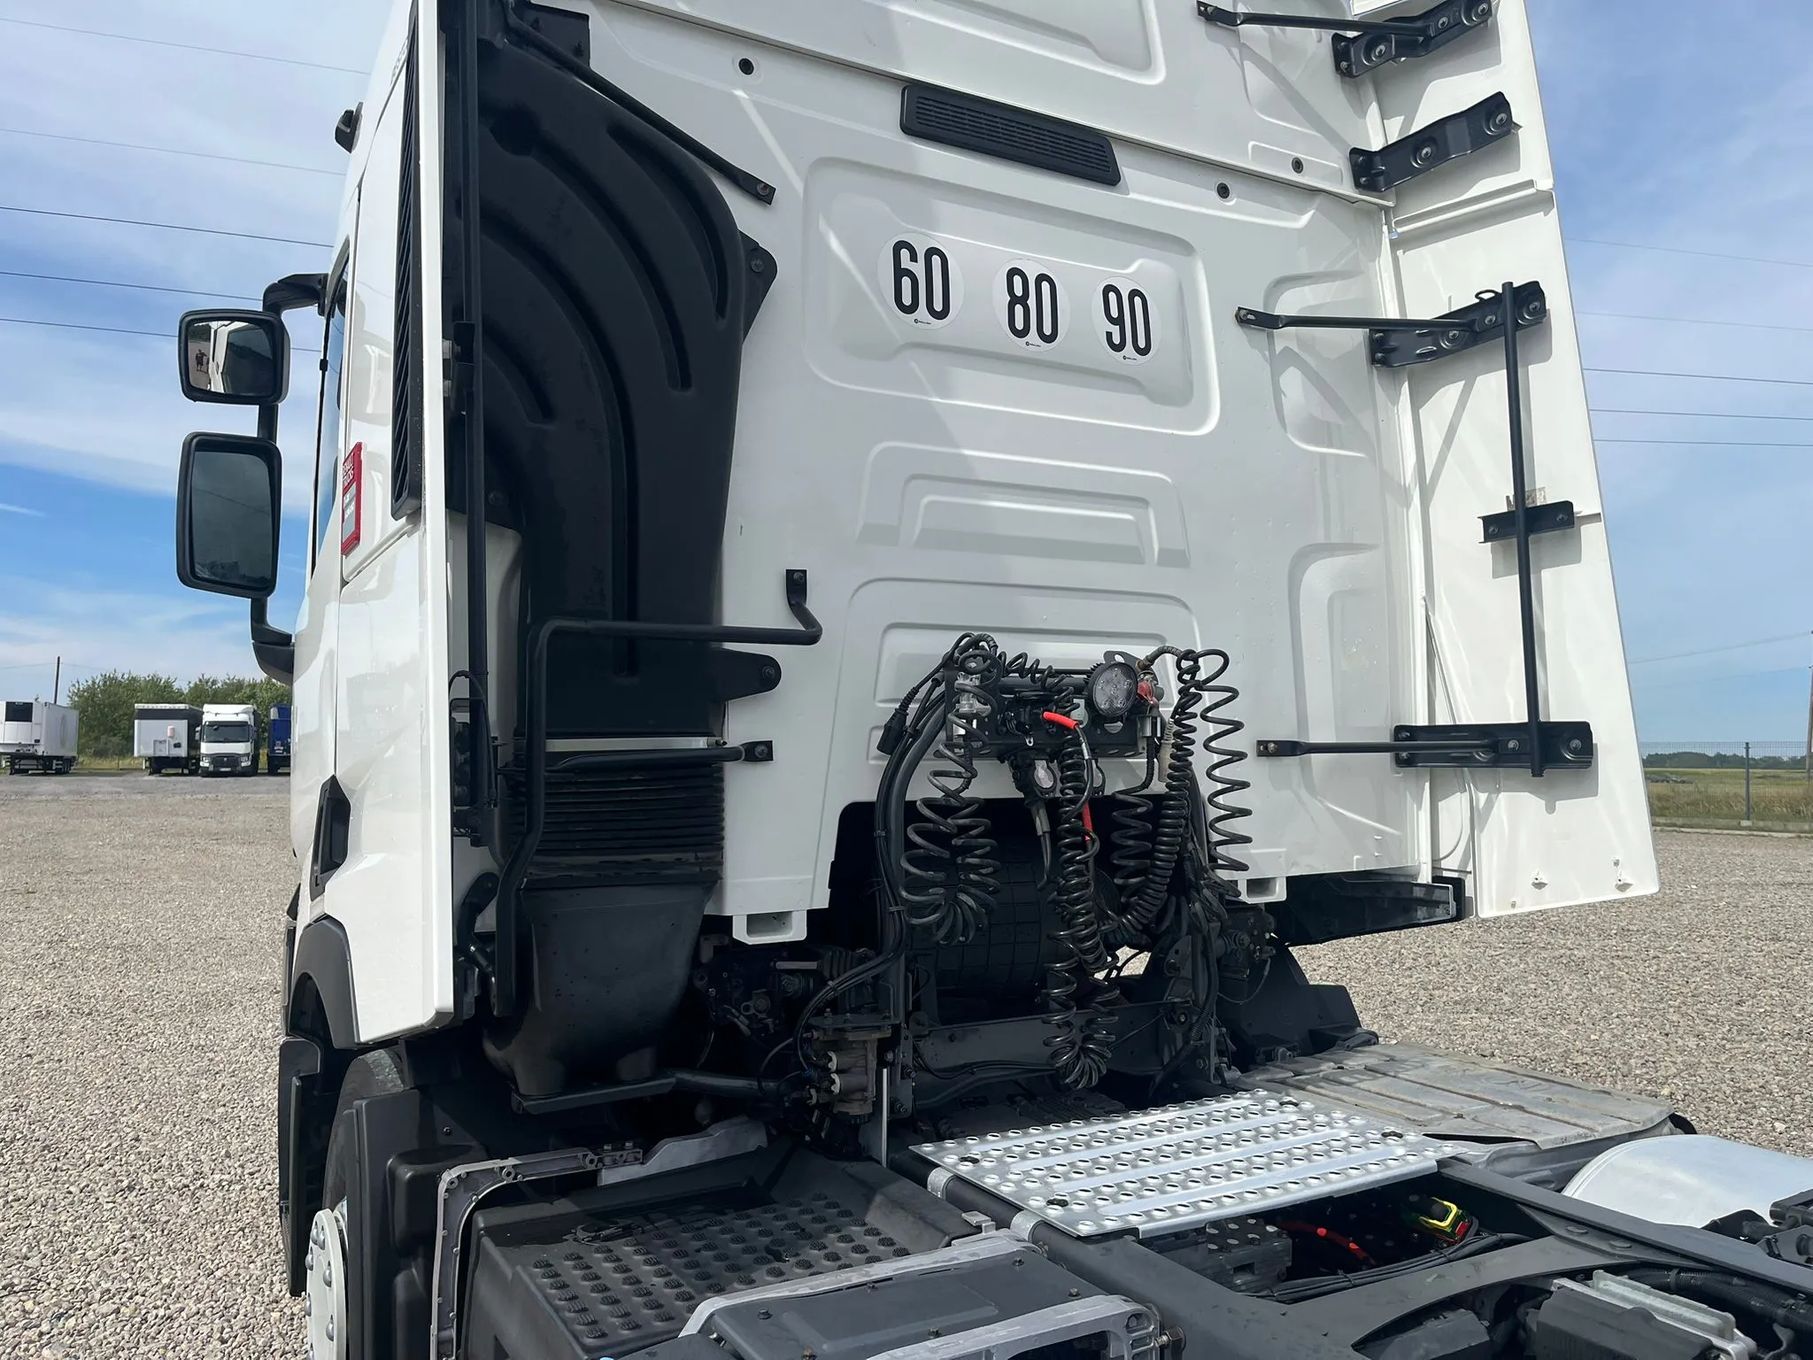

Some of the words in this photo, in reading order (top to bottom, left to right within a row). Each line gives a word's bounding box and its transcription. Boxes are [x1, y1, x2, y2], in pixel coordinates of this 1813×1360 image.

[892, 239, 951, 321] 60
[1006, 266, 1059, 344] 80
[1102, 283, 1152, 357] 90
